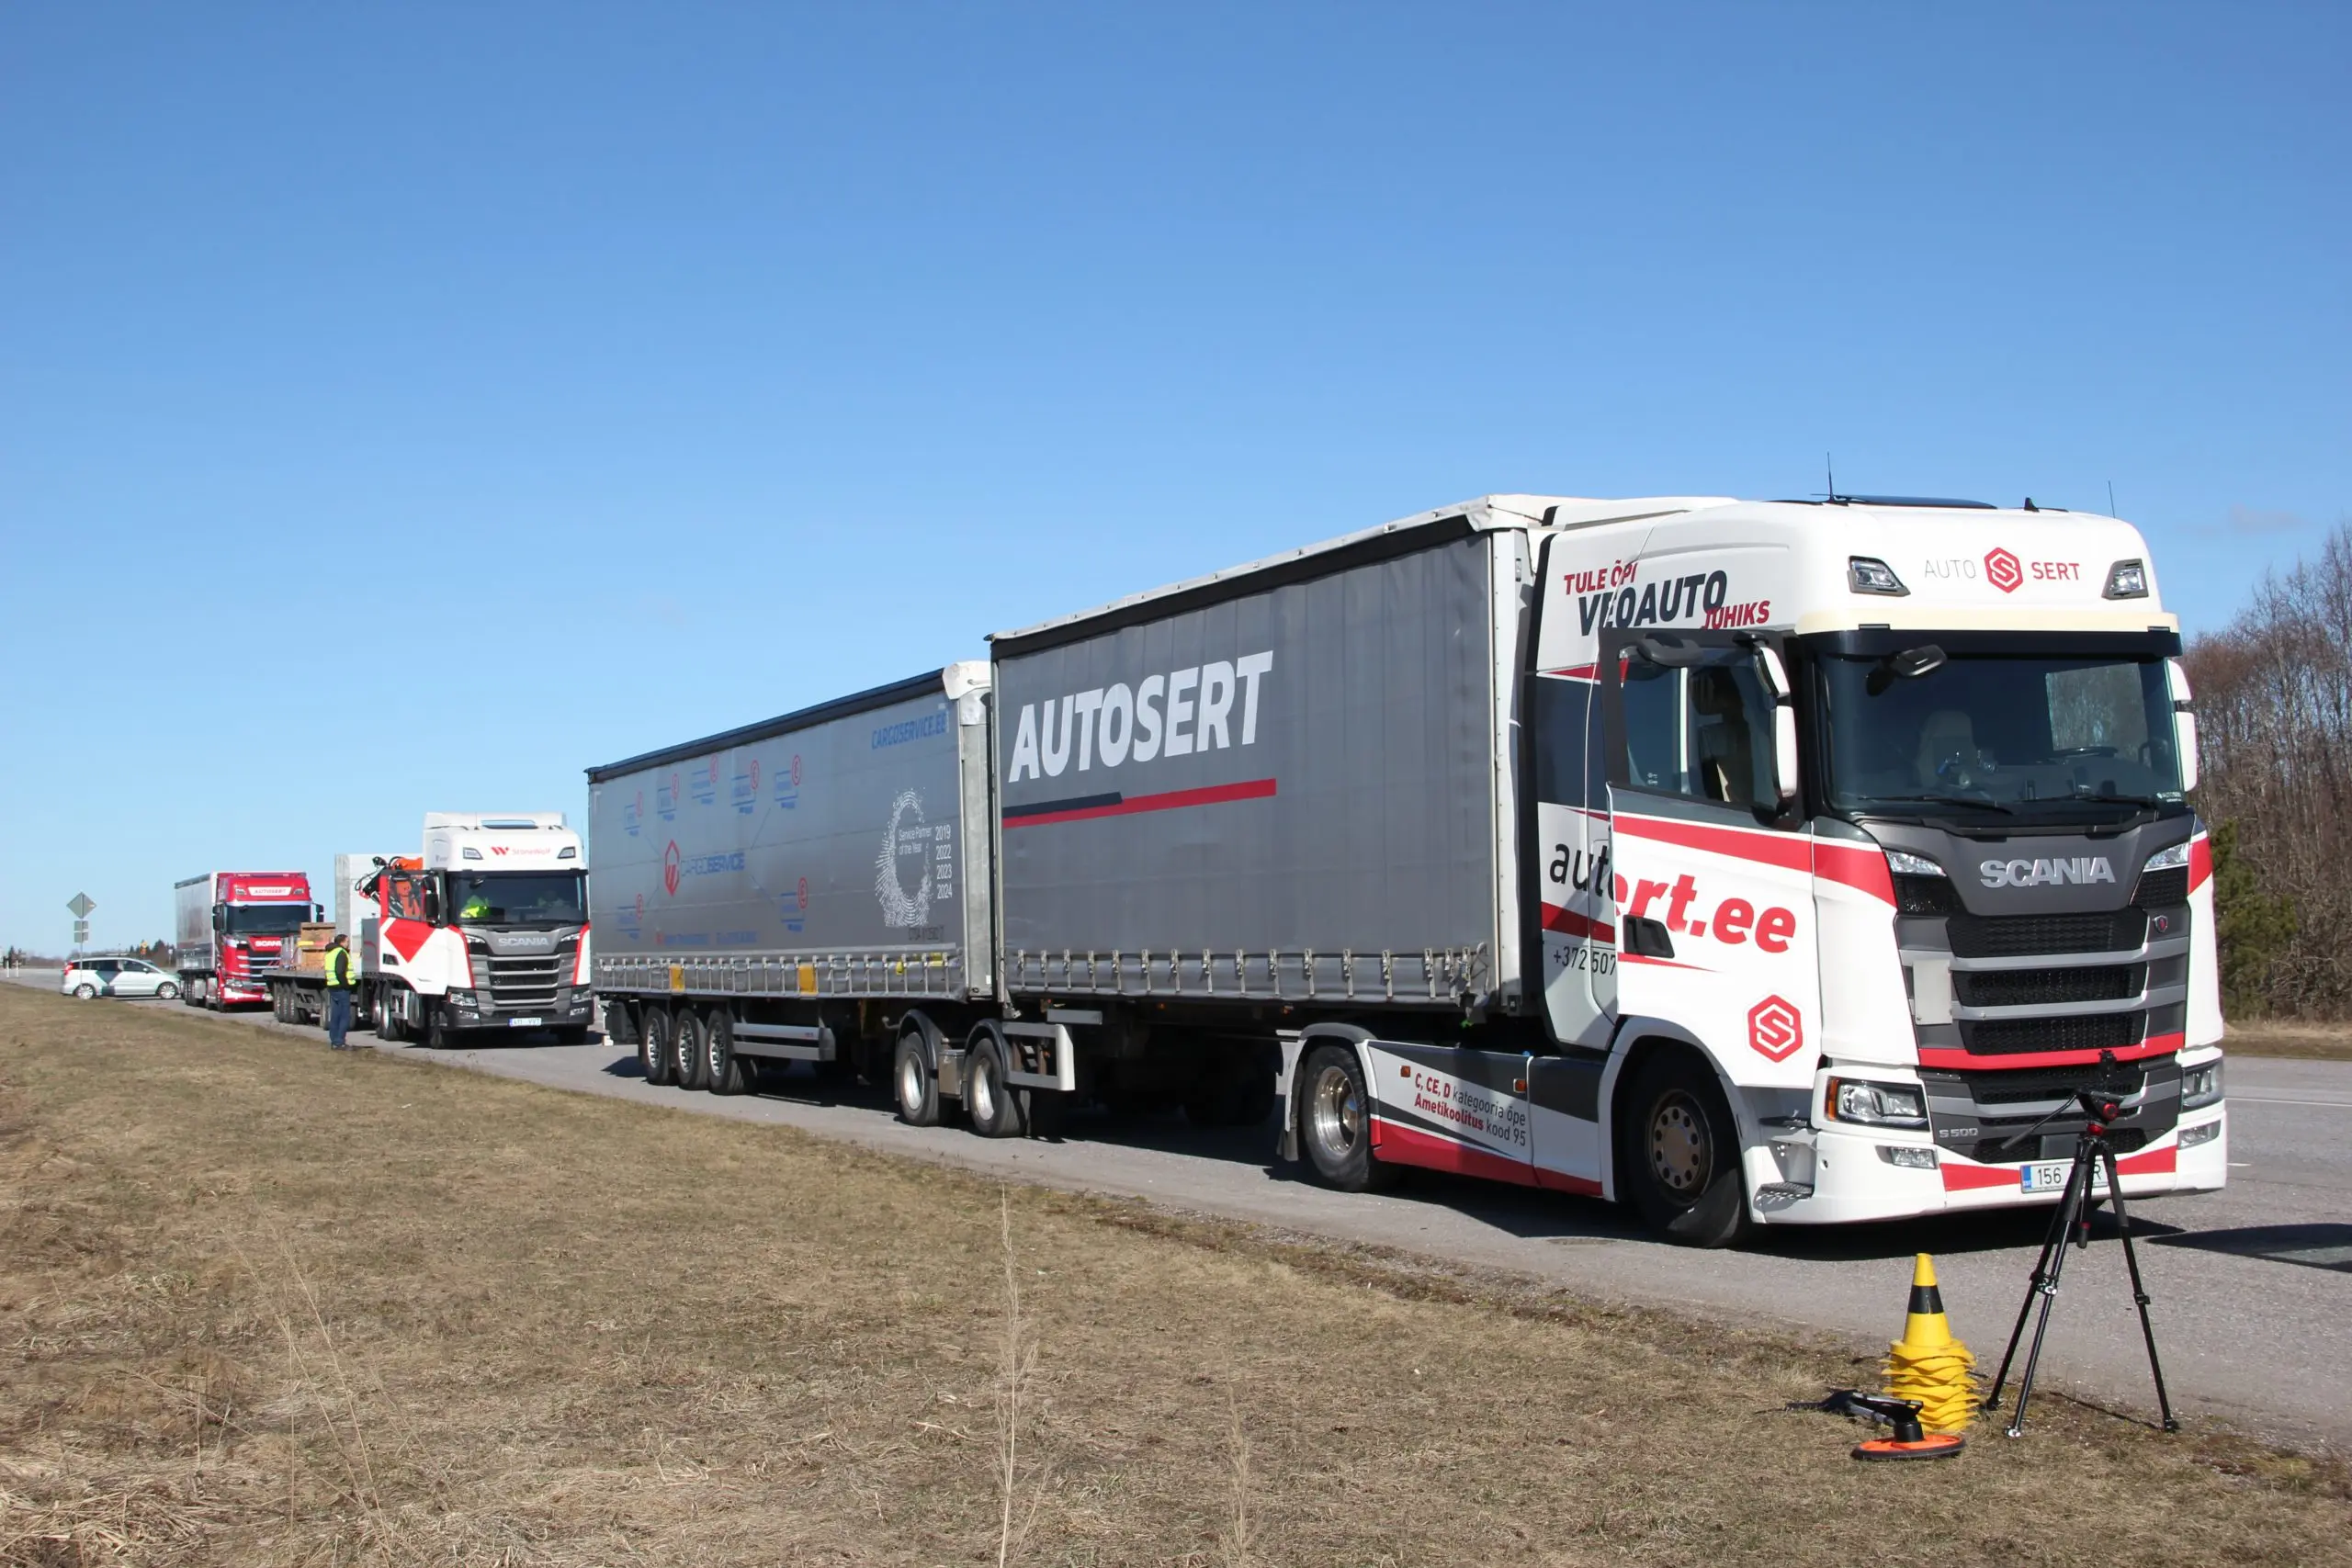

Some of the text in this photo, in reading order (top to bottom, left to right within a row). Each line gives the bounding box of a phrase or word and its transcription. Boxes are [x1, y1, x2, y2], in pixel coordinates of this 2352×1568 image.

[1564, 559, 1638, 595] TULE ÕPI
[1924, 559, 1976, 579] AUTO
[2030, 561, 2079, 581] SERT
[1577, 570, 1727, 637] VEOAUTO
[1701, 600, 1770, 630] JUHIKS
[1008, 650, 1273, 783] AUTOSERT
[935, 824, 951, 840] 2019
[936, 843, 952, 860] 2022
[937, 863, 952, 879] 2023
[1549, 842, 1615, 902] aut
[1979, 856, 2116, 888] SCANIA
[937, 883, 952, 899] 2024
[498, 937, 548, 947] SCANIA
[1553, 946, 1587, 971] +372
[1415, 1072, 1525, 1126] C, CE, D kategooria õpe
[1414, 1093, 1527, 1146] Ametikoolitus kood 95
[1939, 1127, 1978, 1138] S 500
[2038, 1167, 2062, 1185] 156
